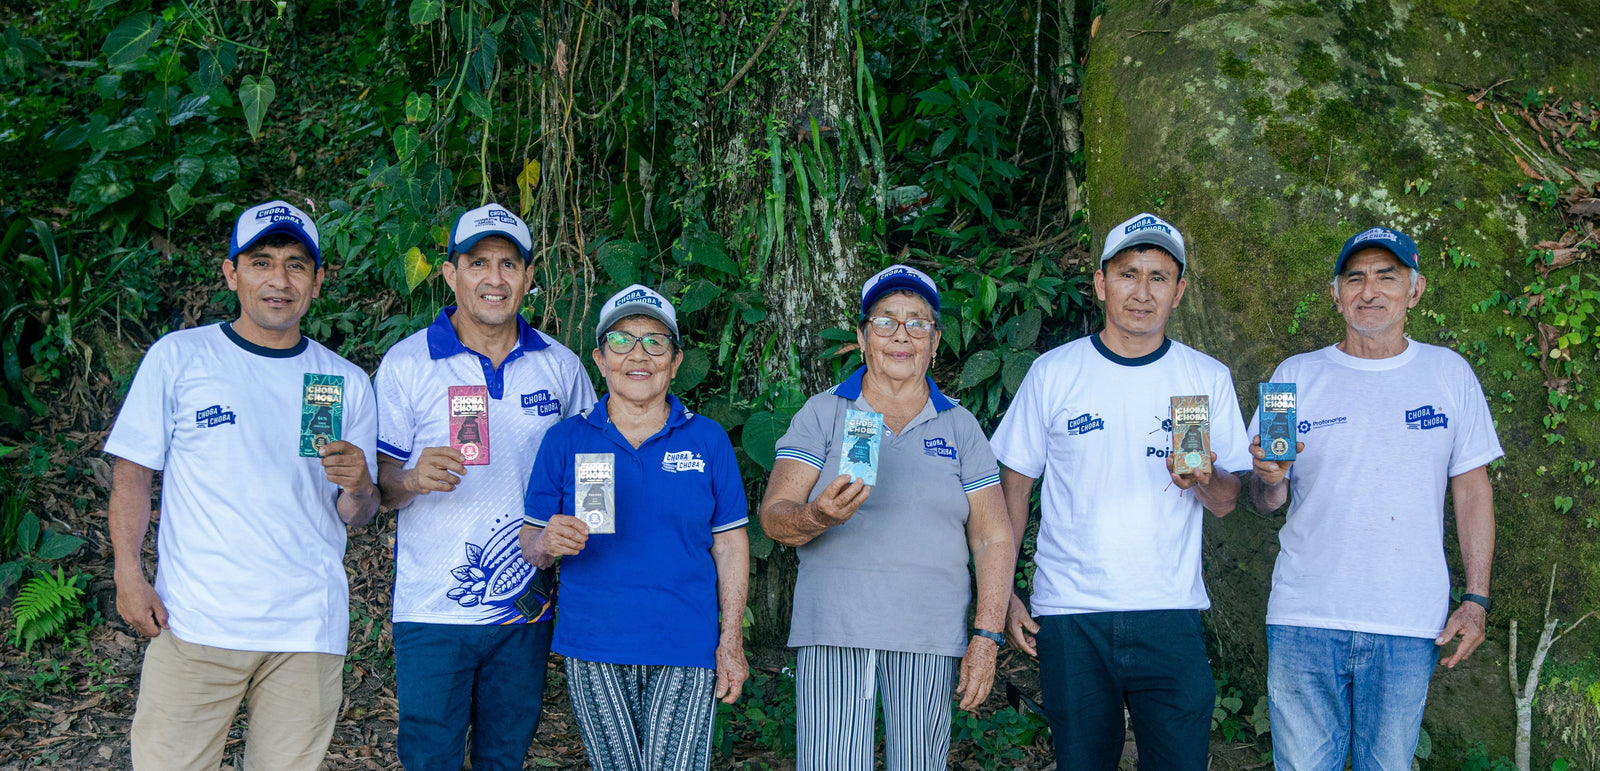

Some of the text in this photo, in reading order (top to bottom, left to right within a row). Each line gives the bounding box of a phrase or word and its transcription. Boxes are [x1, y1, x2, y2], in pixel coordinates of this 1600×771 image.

[258, 207, 285, 217] CHOBA
[1127, 218, 1152, 232] CHOBA
[880, 269, 903, 280] CHOBA
[616, 291, 641, 306] CHOBA
[308, 386, 340, 395] CHOBA
[308, 393, 339, 402] CHOBA
[453, 396, 484, 405] CHOBA
[523, 393, 547, 405] CHOBA
[1265, 393, 1294, 401] CHOBA
[453, 404, 484, 412] CHOBA
[539, 402, 559, 414] CHOBA
[198, 407, 218, 420] CHOBA
[1177, 413, 1207, 421] CHOBA
[1408, 408, 1431, 420] CHOBA
[210, 414, 231, 425] CHOBA
[848, 419, 878, 429] CHOBA
[1070, 415, 1088, 428] CHOBA
[1423, 416, 1444, 427] CHOBA
[1081, 420, 1100, 432] CHOBA
[848, 427, 878, 436] CHOBA
[925, 440, 944, 448] CHOBA
[666, 453, 689, 462] CHOBA
[679, 461, 700, 469] CHOBA
